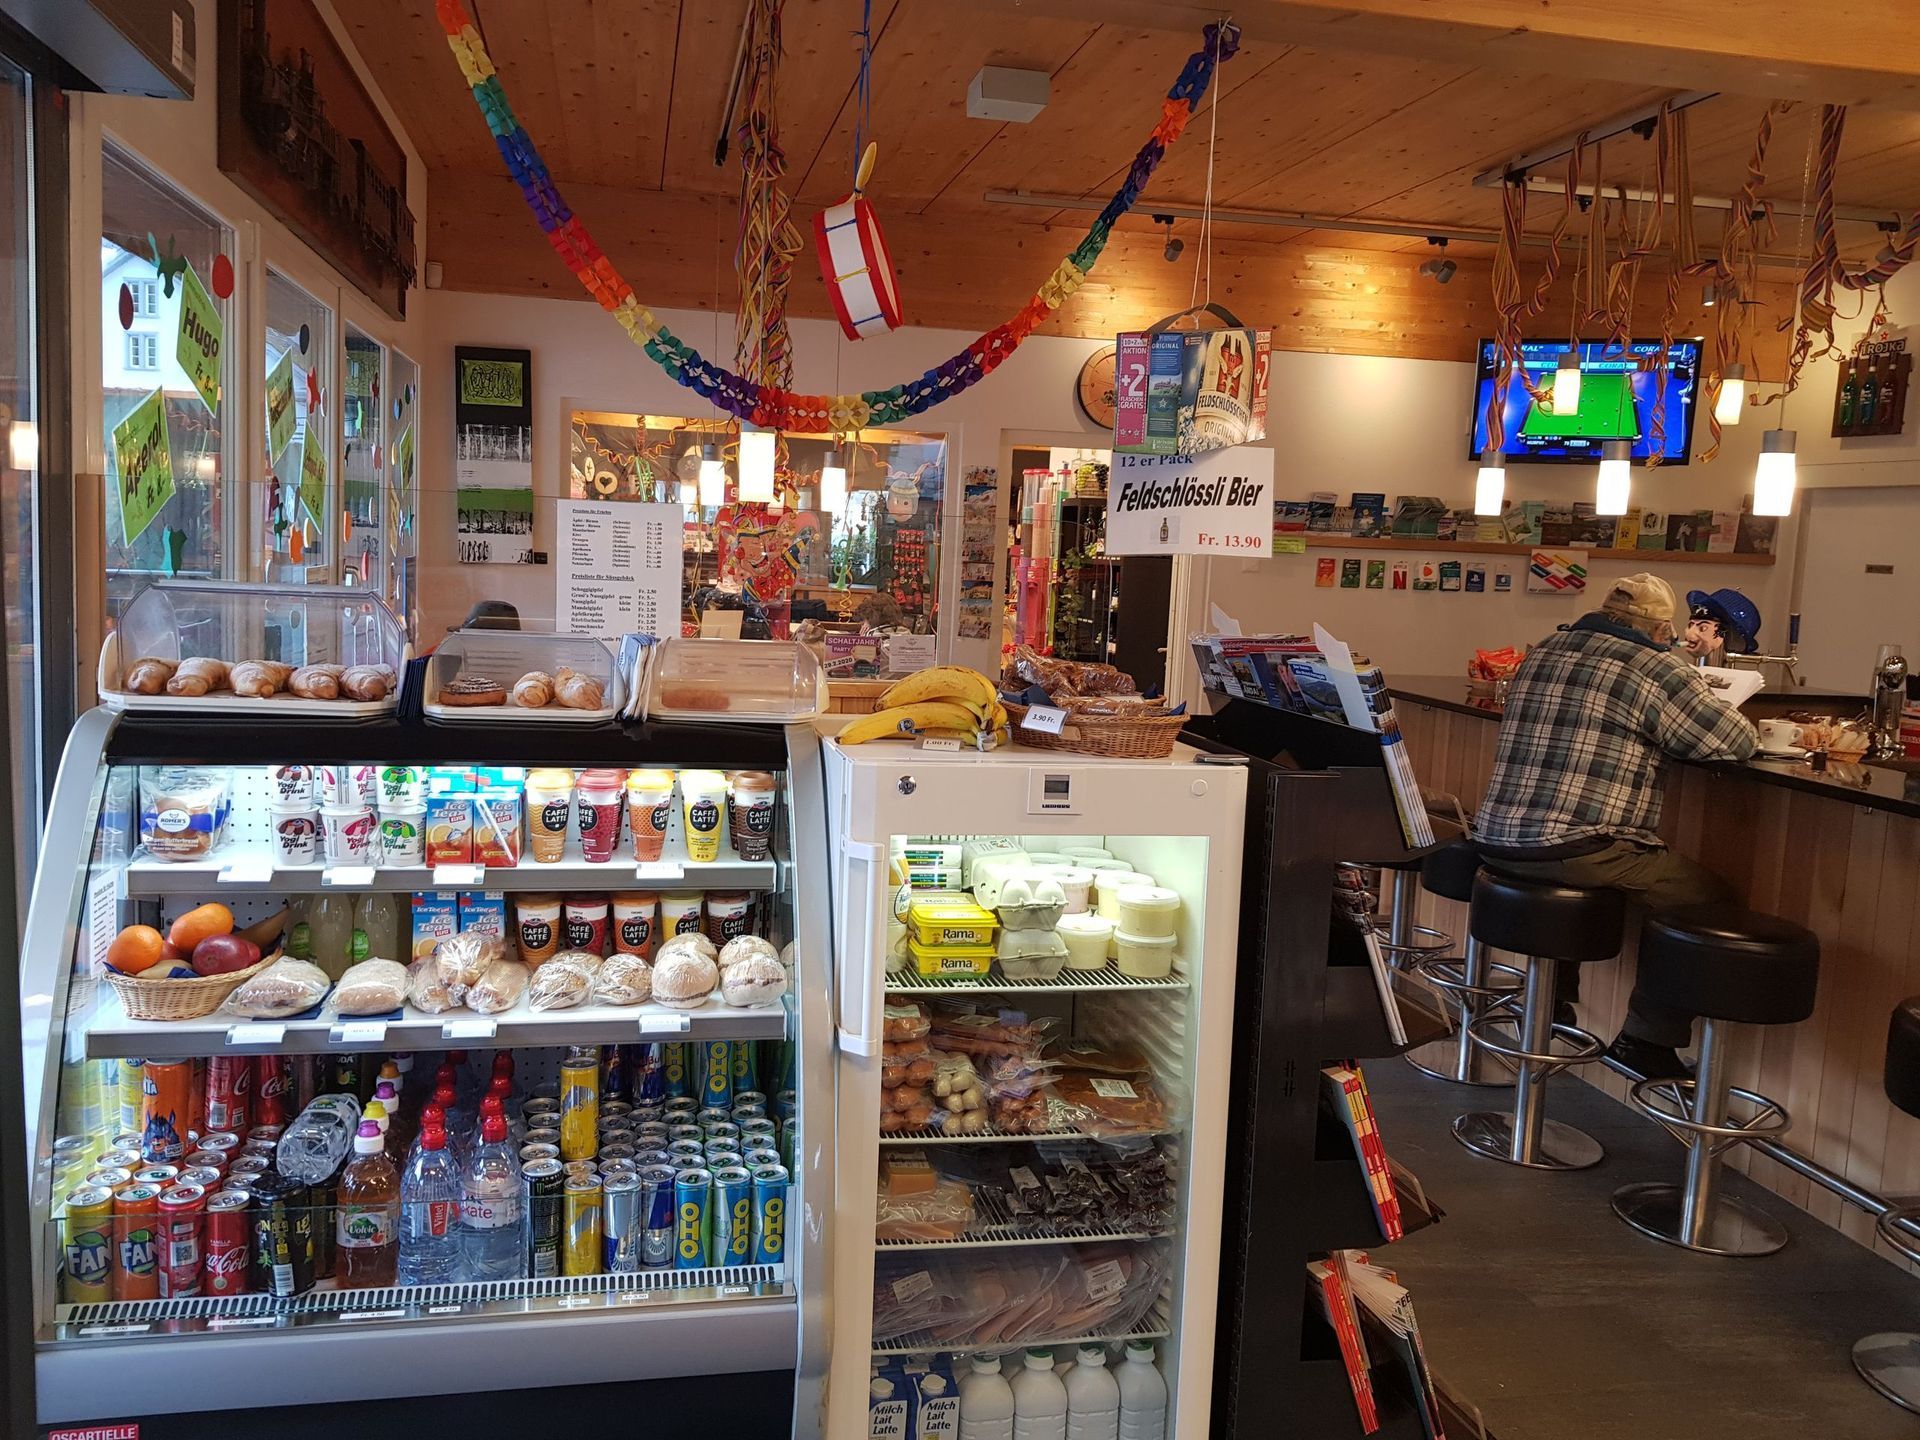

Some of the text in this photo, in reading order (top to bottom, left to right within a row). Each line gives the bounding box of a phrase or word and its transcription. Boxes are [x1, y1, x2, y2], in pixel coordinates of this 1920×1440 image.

[182, 306, 219, 358] Hugo
[1122, 347, 1147, 355] AKTION
[1256, 354, 1269, 397] +2
[1122, 364, 1146, 397] +2
[124, 405, 162, 506] Aperol
[1120, 454, 1194, 468] 12 er Pack
[1116, 476, 1264, 512] Feldschlössli Bier
[1198, 533, 1262, 550] Fr. 13.90
[828, 638, 876, 646] SCHALTJAHR
[824, 658, 853, 669] 29.2.2020
[278, 782, 298, 790] Yogi
[383, 782, 403, 791] Yogi
[442, 802, 467, 811] Ice
[490, 802, 514, 811] Ice
[431, 809, 458, 818] Tea
[692, 808, 717, 817] CAFFÈ
[546, 814, 567, 823] LATTE
[750, 816, 770, 824] LATTE
[280, 836, 300, 844] Yogi
[347, 836, 365, 844] Yogi
[382, 836, 398, 844] Yogi
[430, 916, 452, 924] Ice
[478, 916, 499, 924] Ice
[418, 923, 446, 932] Tea
[523, 925, 548, 934] CAFFÈ
[624, 924, 648, 932] CAFFÈ
[943, 928, 974, 939] Rama
[941, 958, 972, 969] Rama
[434, 1204, 444, 1228] Vittel
[350, 1222, 376, 1234] Volvic
[763, 1197, 784, 1254] OHO
[679, 1202, 700, 1259] OHO
[67, 1237, 112, 1274] FAN
[120, 1242, 156, 1267] FAN
[874, 1404, 904, 1415] Milch
[926, 1401, 956, 1411] Milch
[873, 1415, 892, 1424] Lait
[926, 1412, 945, 1420] Lait
[873, 1425, 898, 1435] Latte
[926, 1421, 951, 1430] Latte
